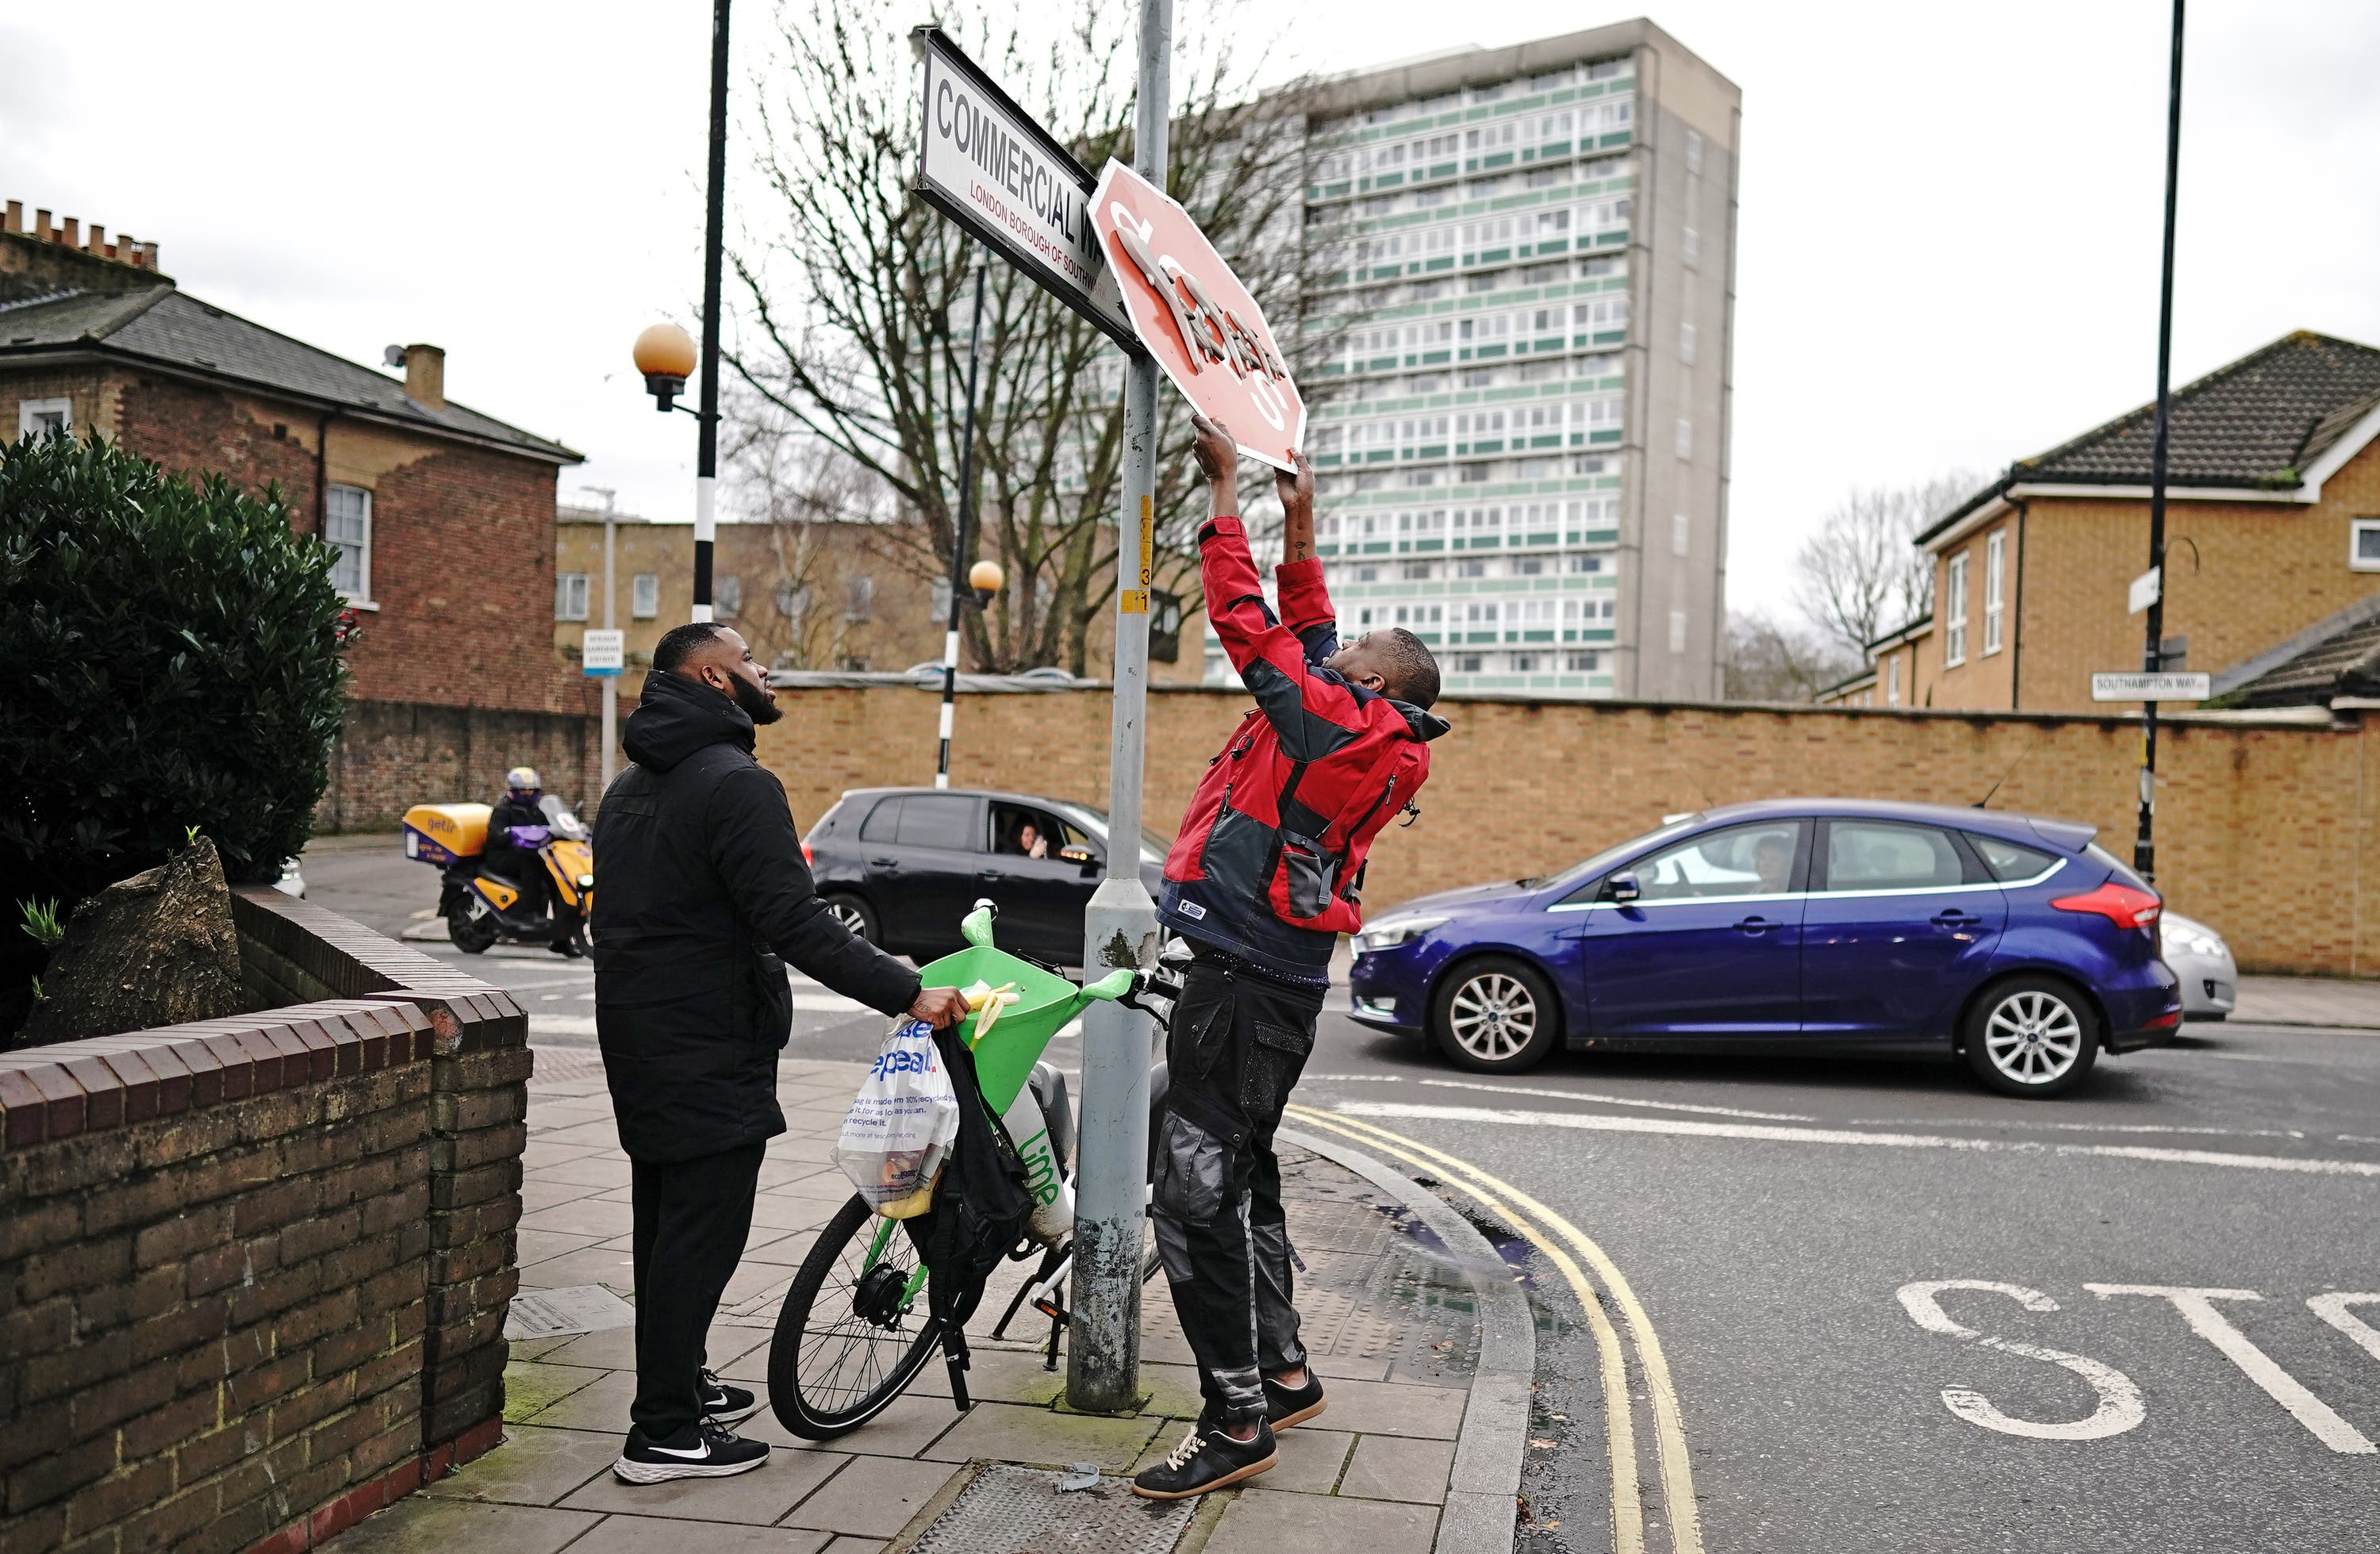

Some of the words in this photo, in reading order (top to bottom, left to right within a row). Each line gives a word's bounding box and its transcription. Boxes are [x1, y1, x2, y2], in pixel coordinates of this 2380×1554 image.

[937, 78, 1075, 244] COMMERCIAL
[1081, 201, 1106, 267] WA
[970, 179, 1008, 223] LONDON
[1010, 210, 1050, 258] BOROUGH
[1051, 245, 1062, 265] OF
[1063, 255, 1107, 301] SOUTHWARK
[2096, 677, 2172, 692] SOUTHAMPTON
[2176, 677, 2196, 689] WAY
[428, 817, 455, 834] getir
[849, 1118, 877, 1126] recycle
